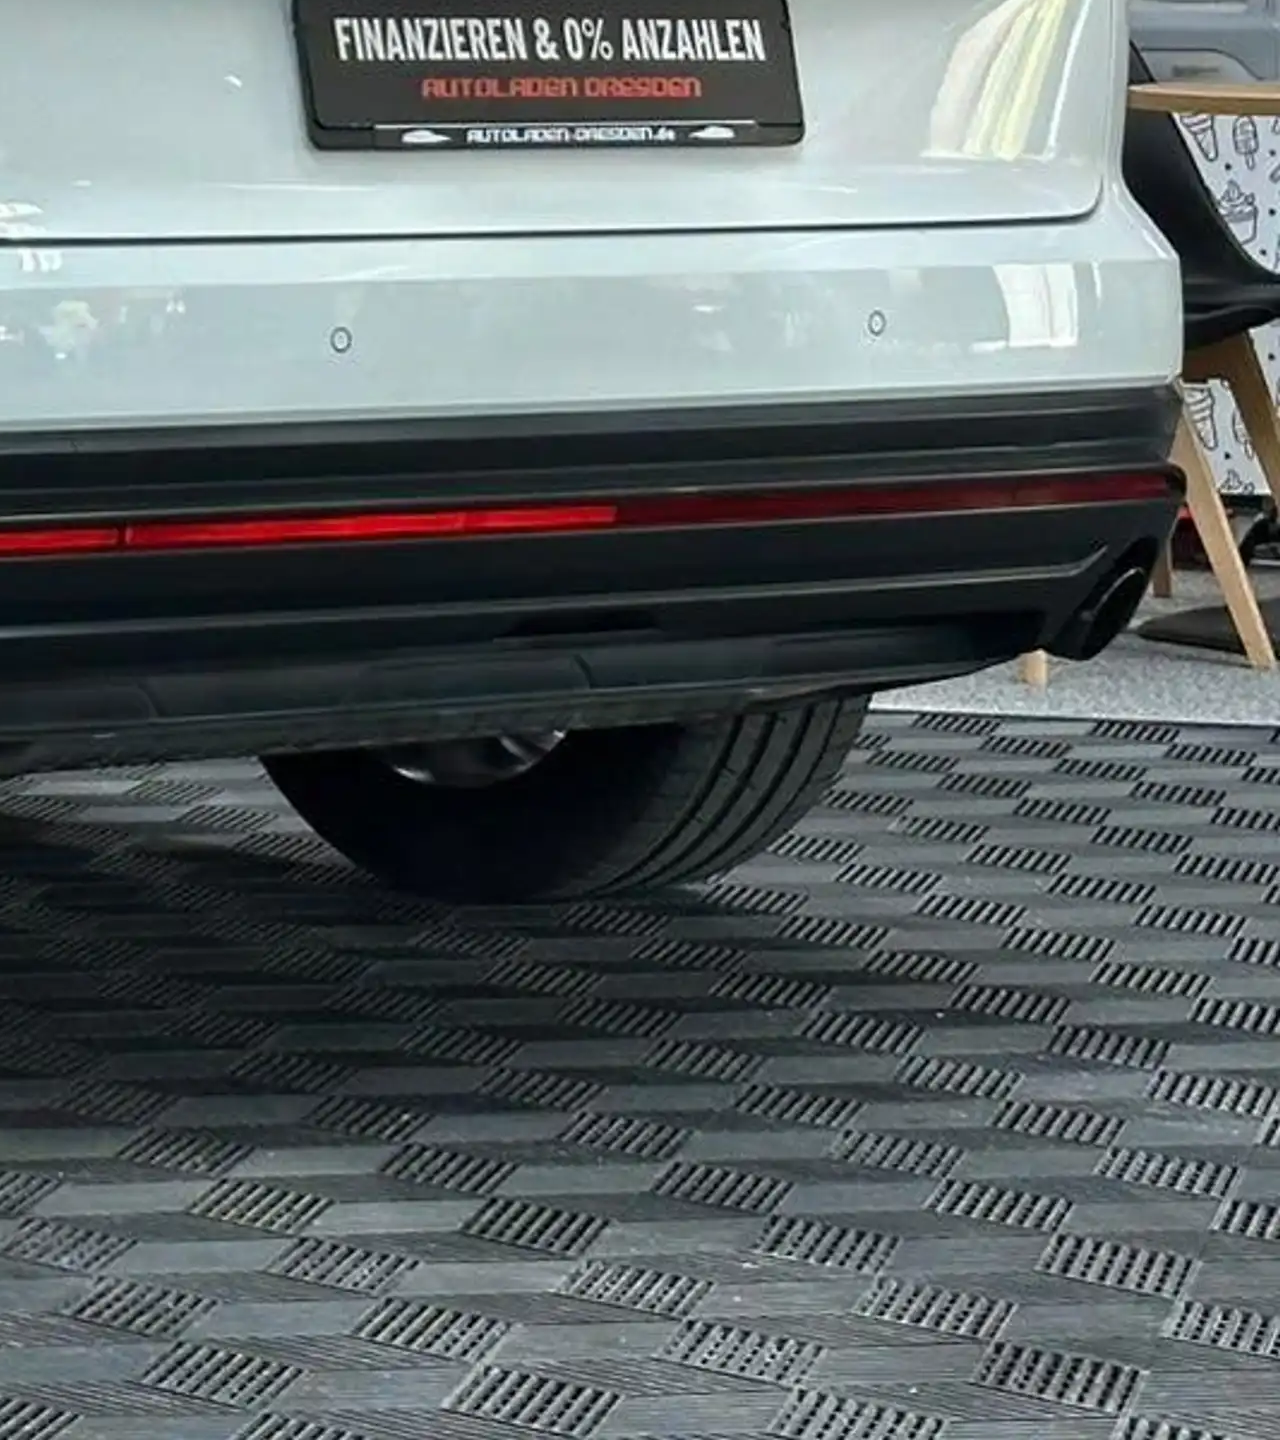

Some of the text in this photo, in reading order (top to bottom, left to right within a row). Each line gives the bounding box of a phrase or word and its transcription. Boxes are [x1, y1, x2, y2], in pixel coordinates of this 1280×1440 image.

[334, 17, 766, 61] FINANZIEREN & 0% ANZAHLEN
[421, 75, 702, 99] AUTOLADEN DRESDEN
